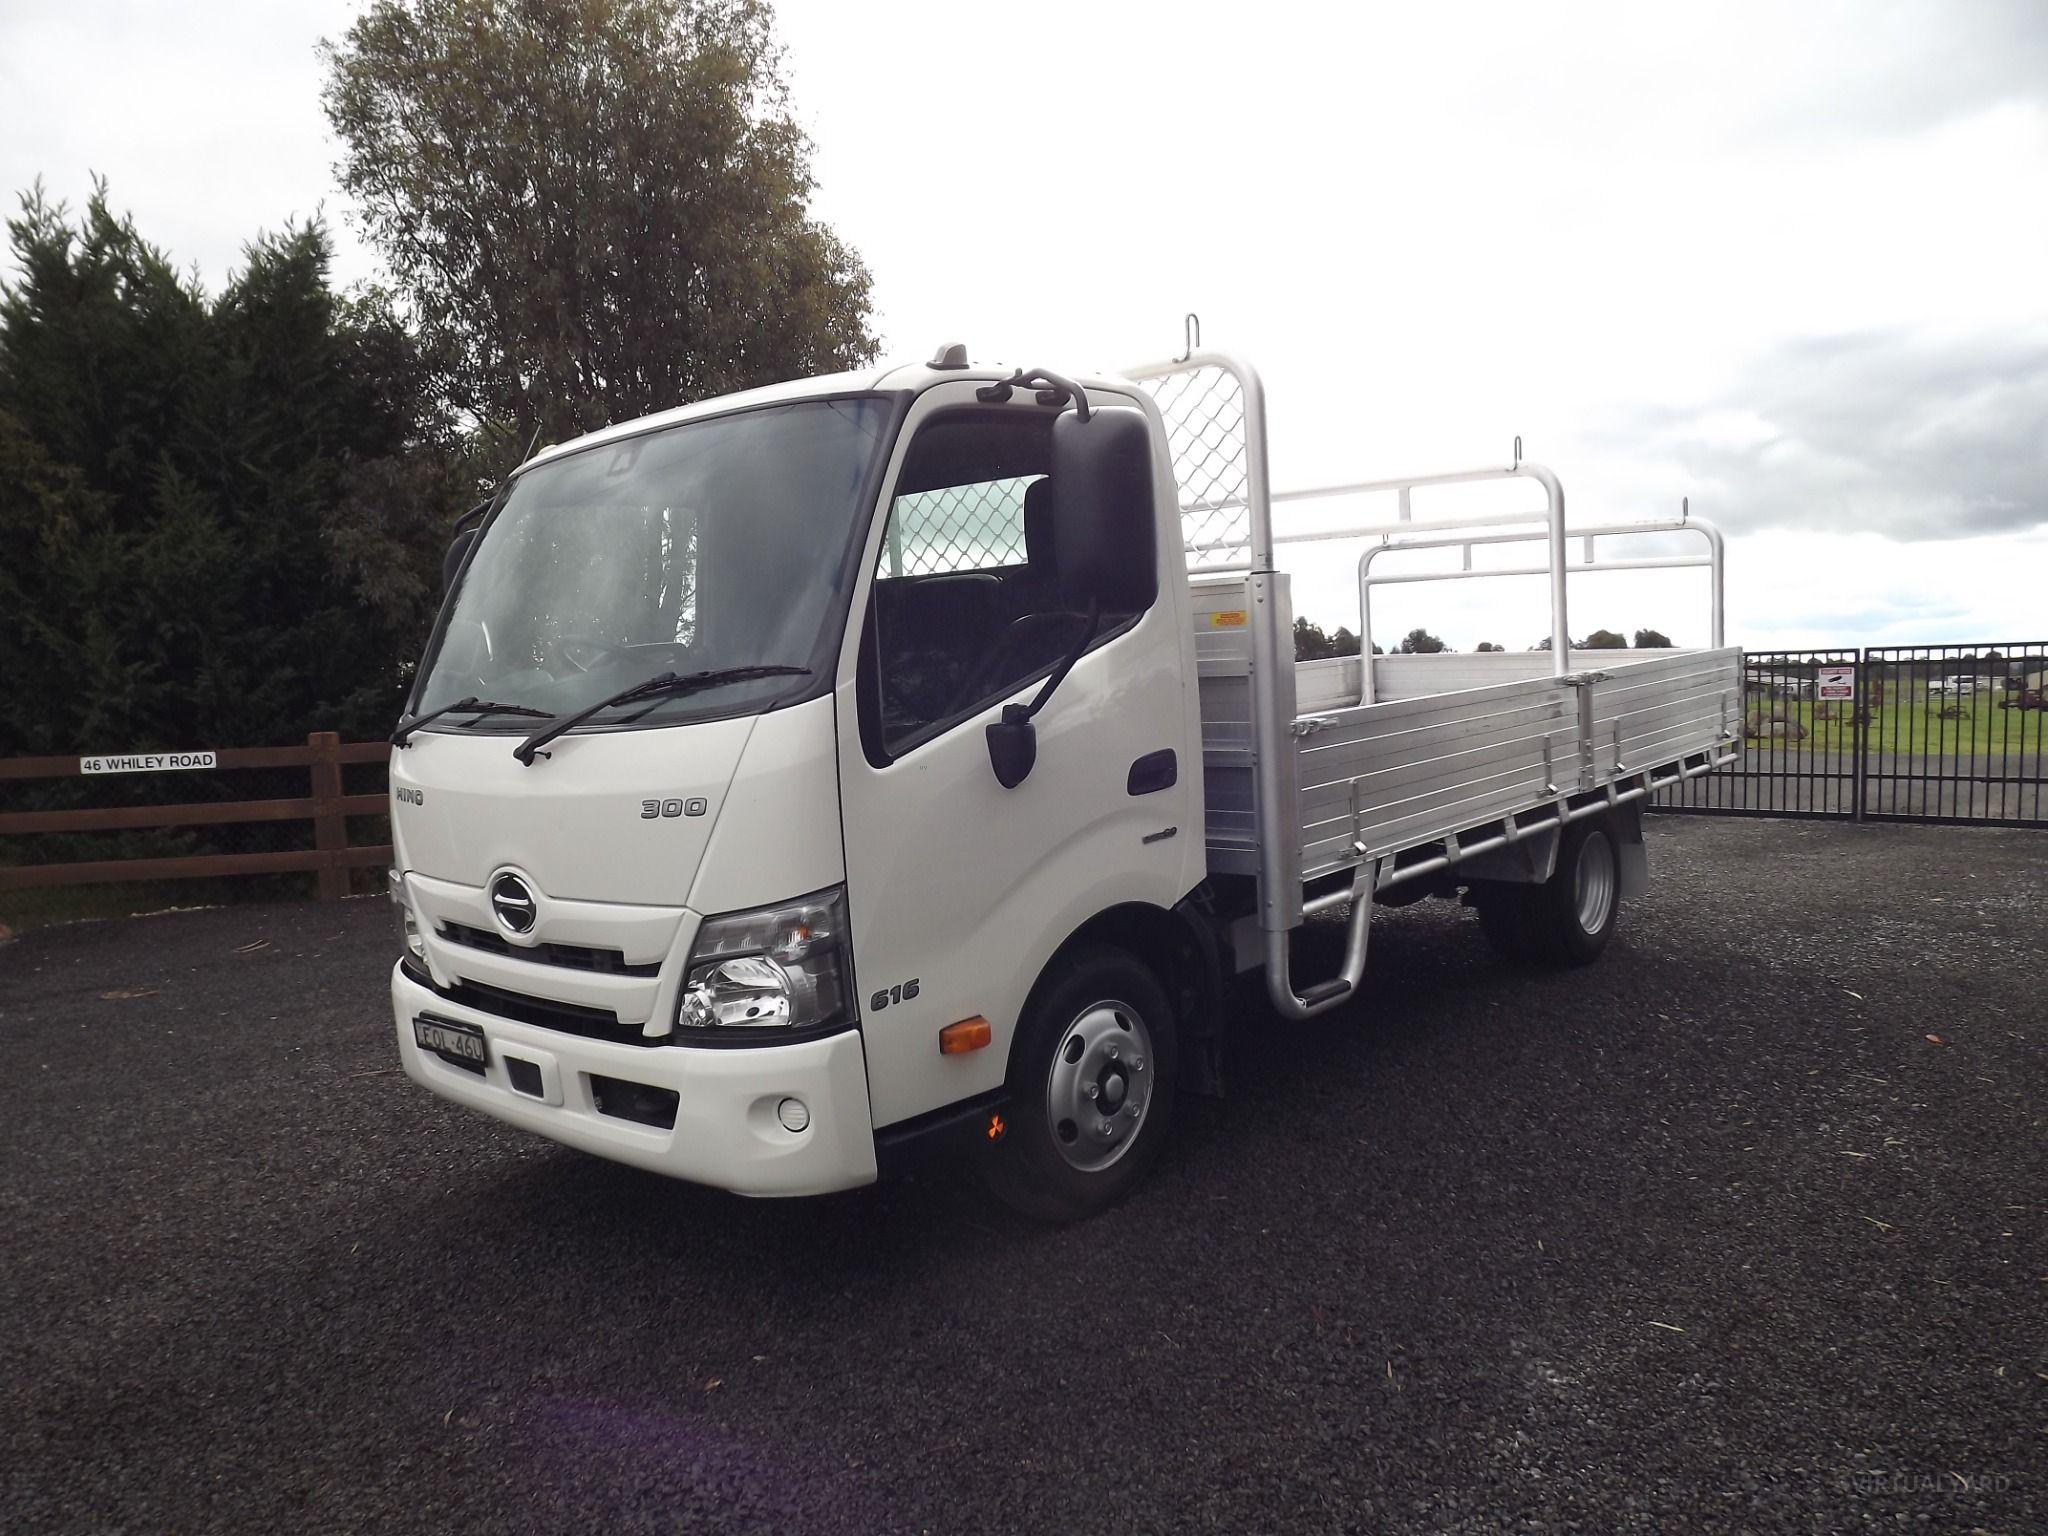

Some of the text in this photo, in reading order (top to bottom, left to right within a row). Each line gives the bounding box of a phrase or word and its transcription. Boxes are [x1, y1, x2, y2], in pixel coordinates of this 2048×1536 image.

[84, 754, 213, 771] 46 WHILEY ROAD
[396, 787, 424, 805] HINO
[641, 797, 707, 819] 300
[870, 977, 920, 1012] 616
